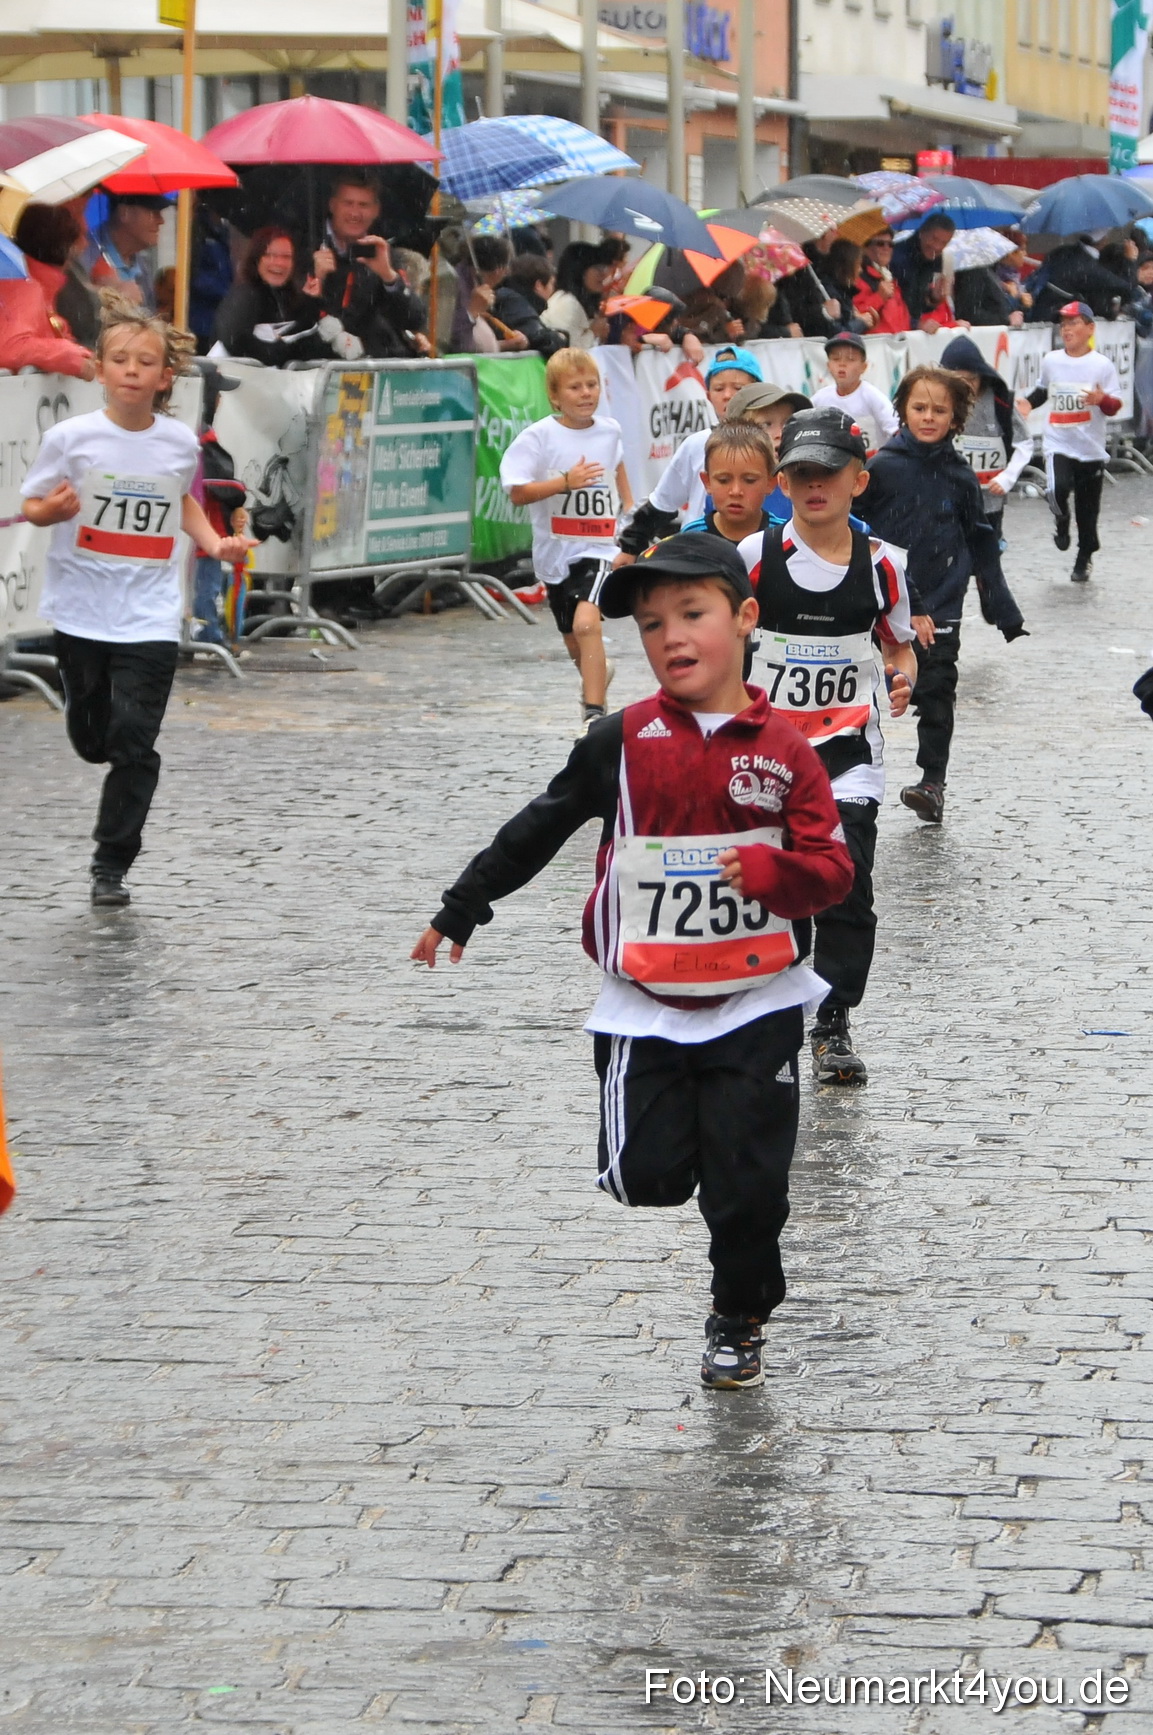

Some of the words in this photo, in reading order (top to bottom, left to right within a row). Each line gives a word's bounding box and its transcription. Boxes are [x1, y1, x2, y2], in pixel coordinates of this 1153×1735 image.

[957, 450, 1001, 469] 112
[93, 494, 171, 533] 7197
[554, 489, 613, 516] 7061
[785, 643, 840, 657] BOCK
[766, 662, 859, 707] 7366
[637, 729, 672, 738] adidas
[730, 755, 750, 771] FC
[753, 754, 793, 784] Holzhe
[664, 846, 733, 866] BOC
[638, 881, 769, 937] 7255
